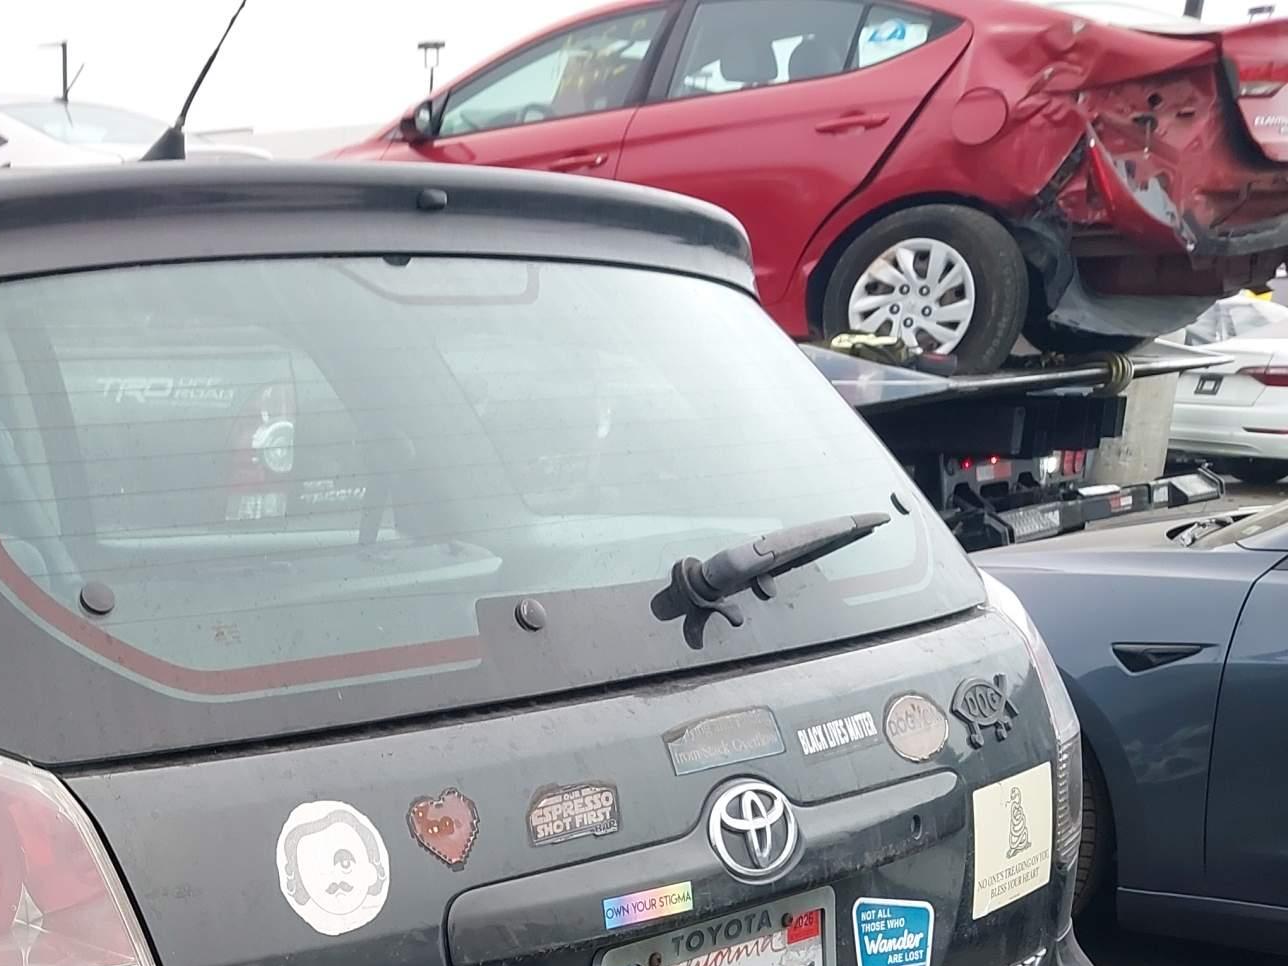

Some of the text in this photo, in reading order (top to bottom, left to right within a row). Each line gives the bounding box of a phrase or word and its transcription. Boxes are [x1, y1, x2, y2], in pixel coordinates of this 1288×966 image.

[97, 377, 174, 403] TRD
[797, 725, 828, 755] BLACK
[822, 719, 849, 748] LIVES
[843, 711, 878, 742] MATTER
[563, 790, 580, 800] OUR
[531, 791, 613, 826] ESPRESSO
[536, 807, 612, 838] SHOT FIRST
[606, 891, 691, 919] OWN YOUR STIGMA
[861, 908, 891, 921] NOT ALL
[671, 910, 772, 956] TOYOTA
[861, 917, 905, 933] THOSE WHO
[864, 929, 924, 955] Wander
[888, 950, 924, 964] ARE LOST
